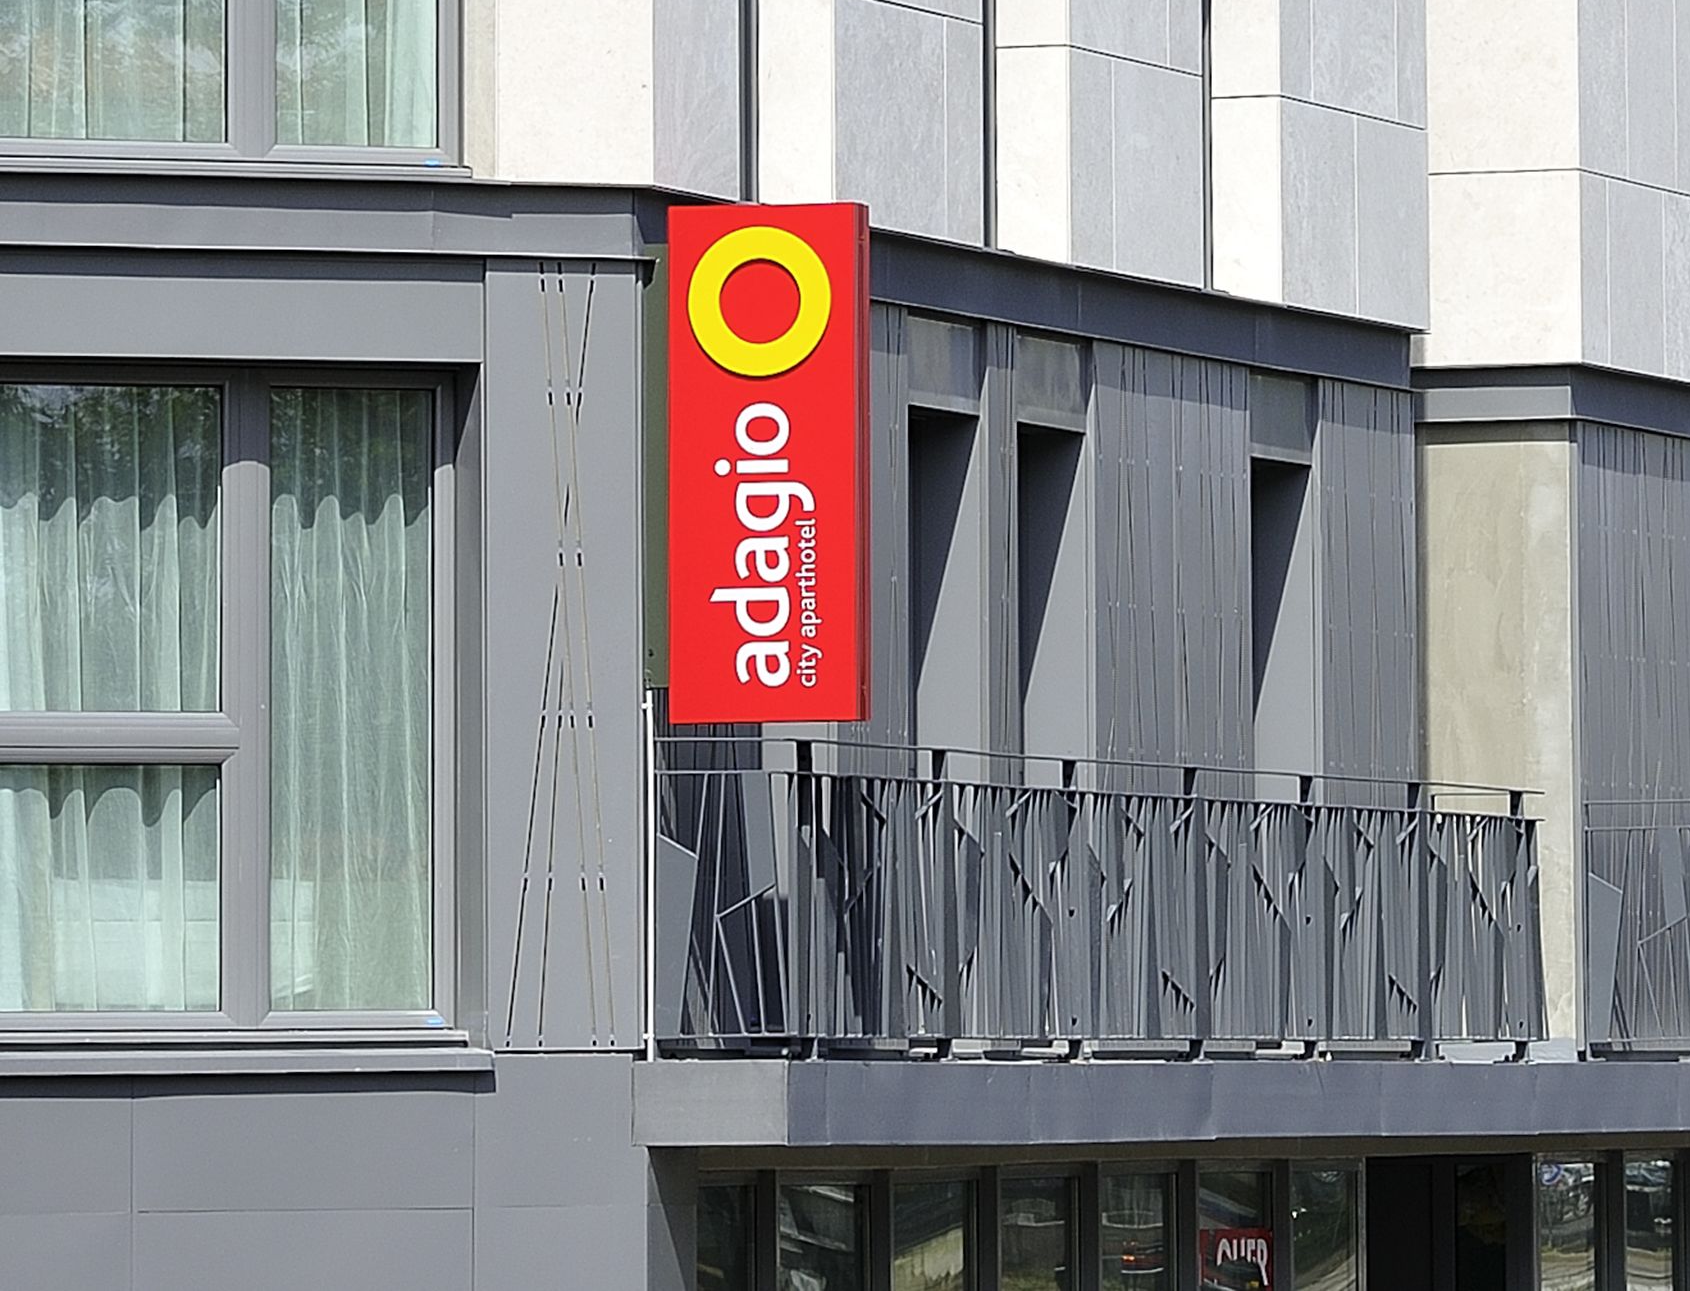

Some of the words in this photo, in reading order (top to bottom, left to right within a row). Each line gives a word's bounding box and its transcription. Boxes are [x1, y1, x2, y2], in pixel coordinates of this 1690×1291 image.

[709, 401, 815, 688] adagio
[796, 518, 823, 639] aparthotel
[796, 641, 823, 688] city
